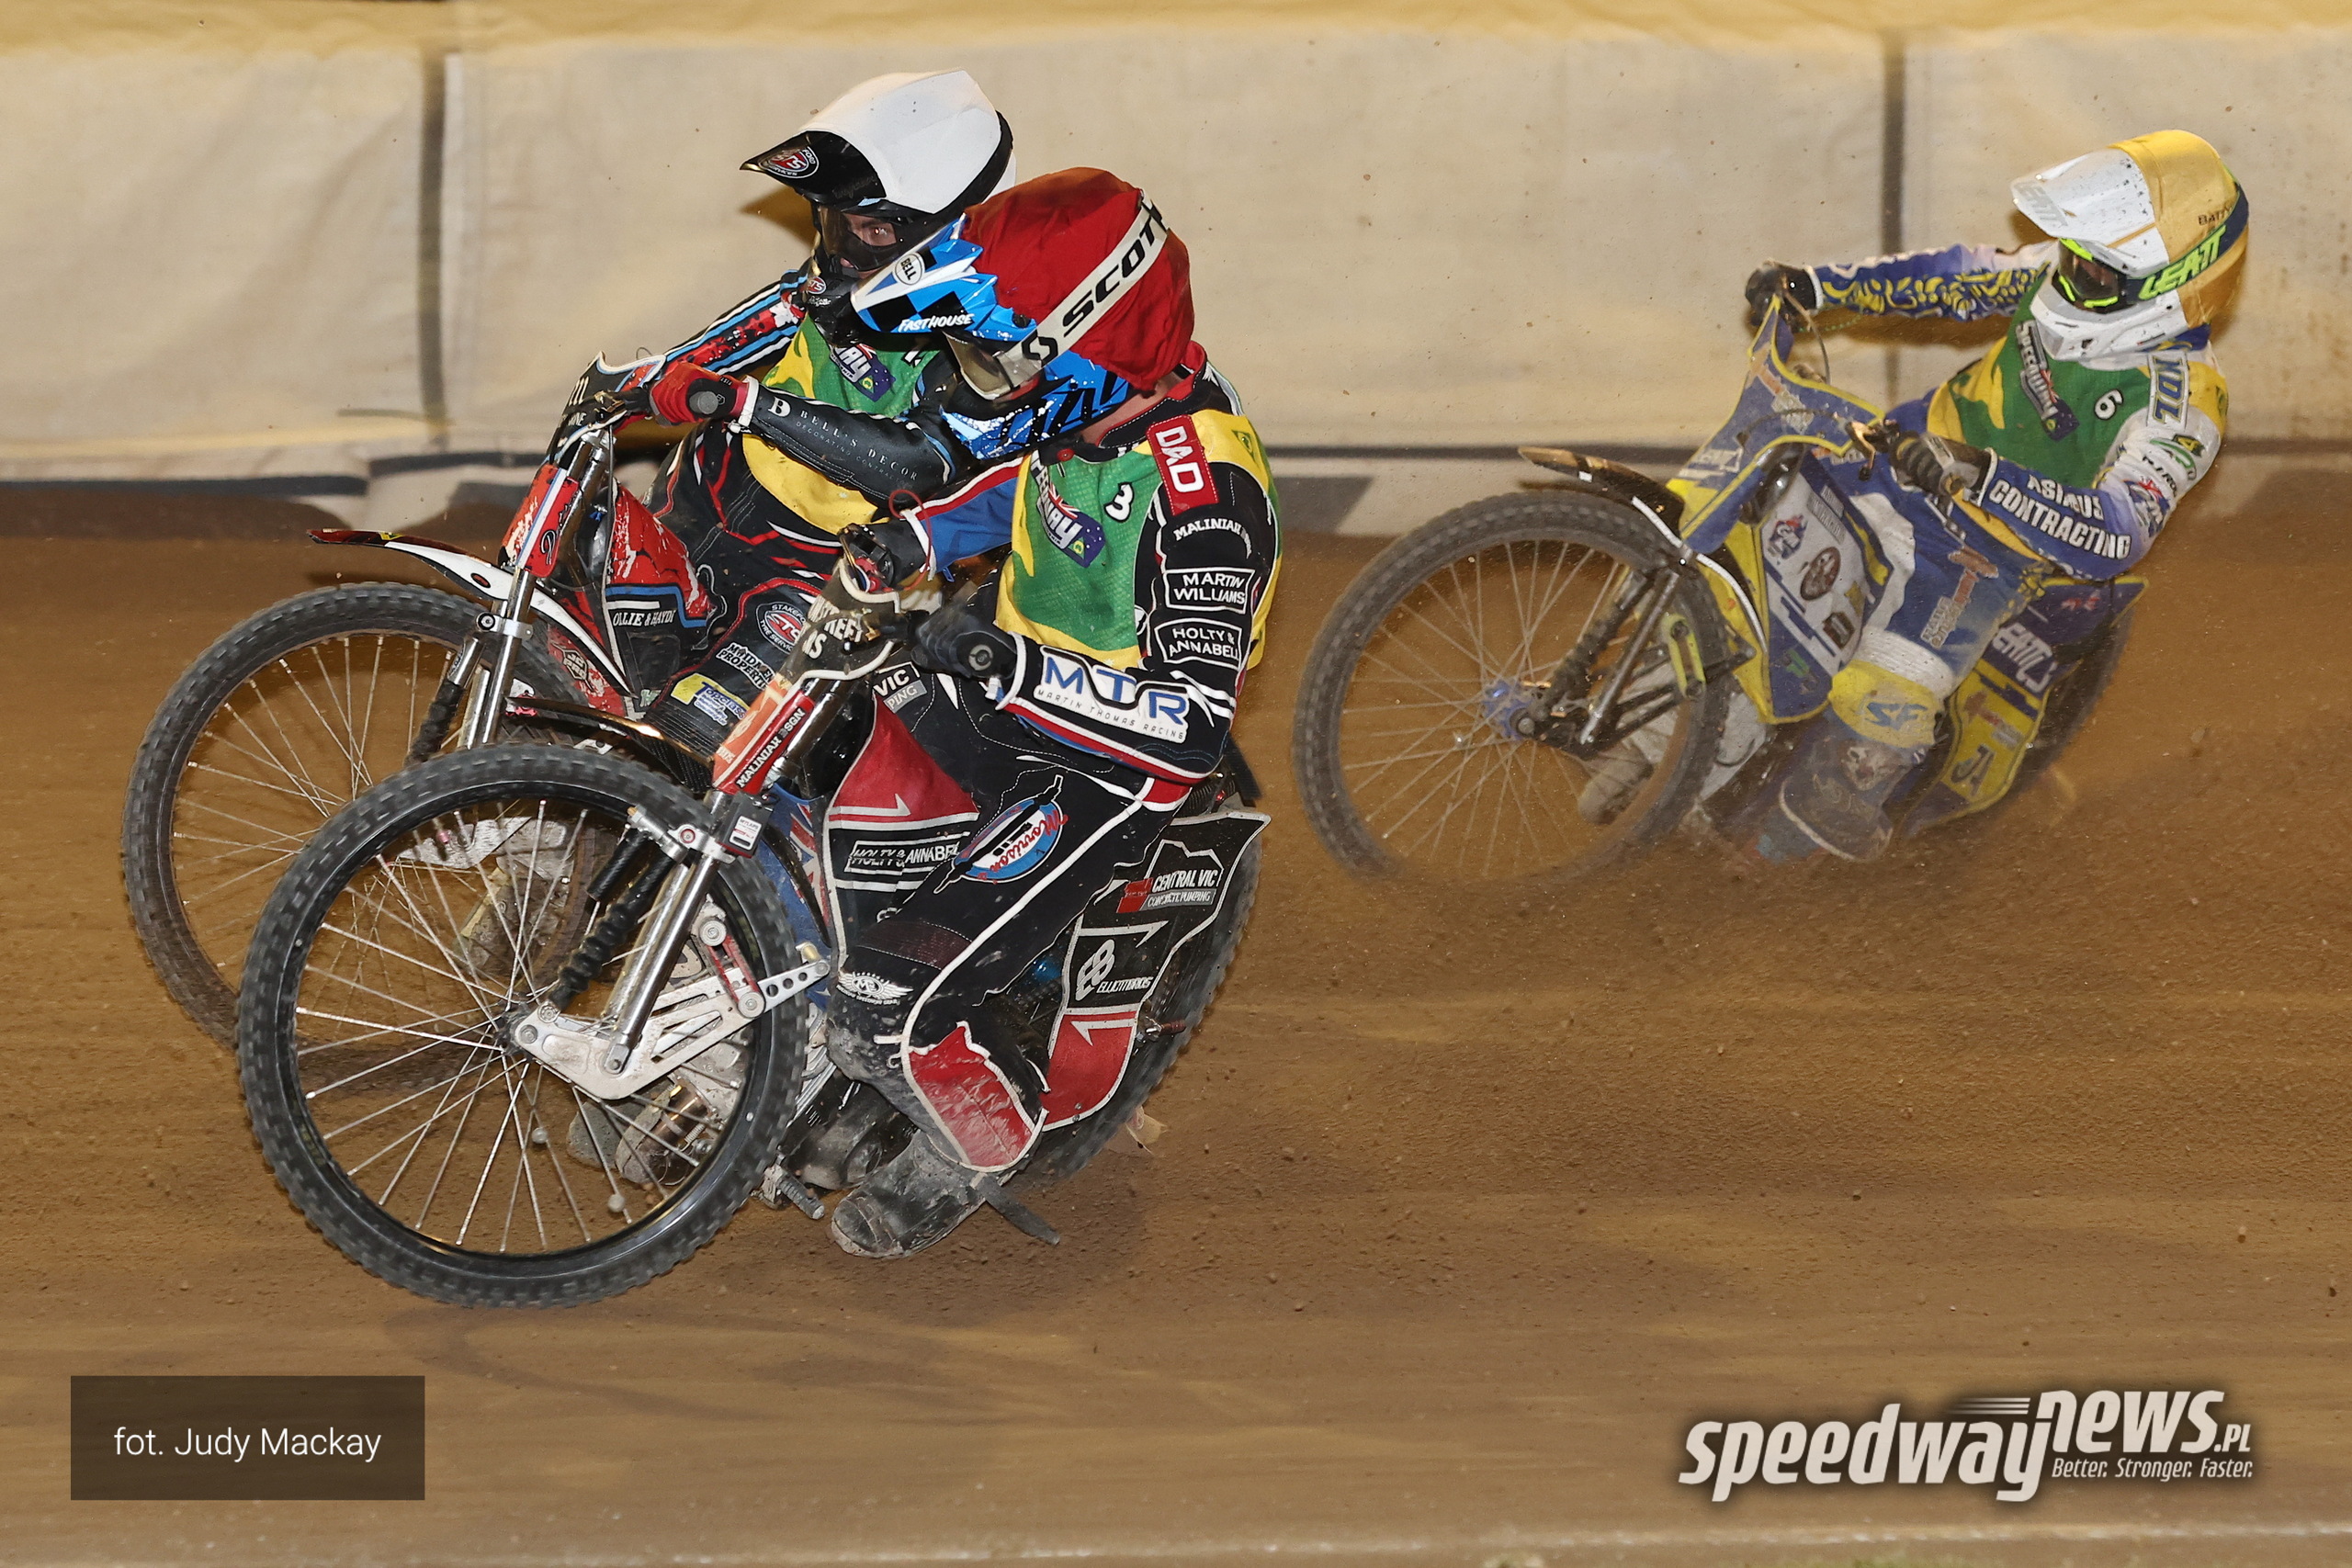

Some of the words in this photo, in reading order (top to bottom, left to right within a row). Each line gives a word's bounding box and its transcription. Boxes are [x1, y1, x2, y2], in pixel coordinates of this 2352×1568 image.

[900, 257, 917, 281] BELL
[2138, 225, 2227, 301] LEATT
[897, 313, 975, 333] FASTHOUSE
[2095, 389, 2123, 420] 6
[800, 410, 858, 447] BELL'S
[867, 448, 918, 480] DECOR
[1155, 425, 1204, 493] DAD
[1104, 483, 1134, 522] 3
[1182, 573, 1245, 589] MARTIN
[1173, 587, 1246, 606] WILLIAMS
[612, 612, 645, 627] OLLIE
[771, 604, 807, 625] STAKEFO
[759, 619, 773, 638] TYRE
[769, 634, 795, 652] SERVIC
[1172, 627, 1226, 642] HOLTY
[718, 650, 768, 689] PROPERTI
[874, 669, 910, 696] VIC
[1045, 657, 1187, 726] MTR
[1037, 689, 1082, 709] MARTIN
[1090, 706, 1136, 727] THOMAS
[1143, 725, 1184, 739] RACING
[1151, 870, 1195, 893] CENTRAL
[1198, 869, 1219, 887] VIC
